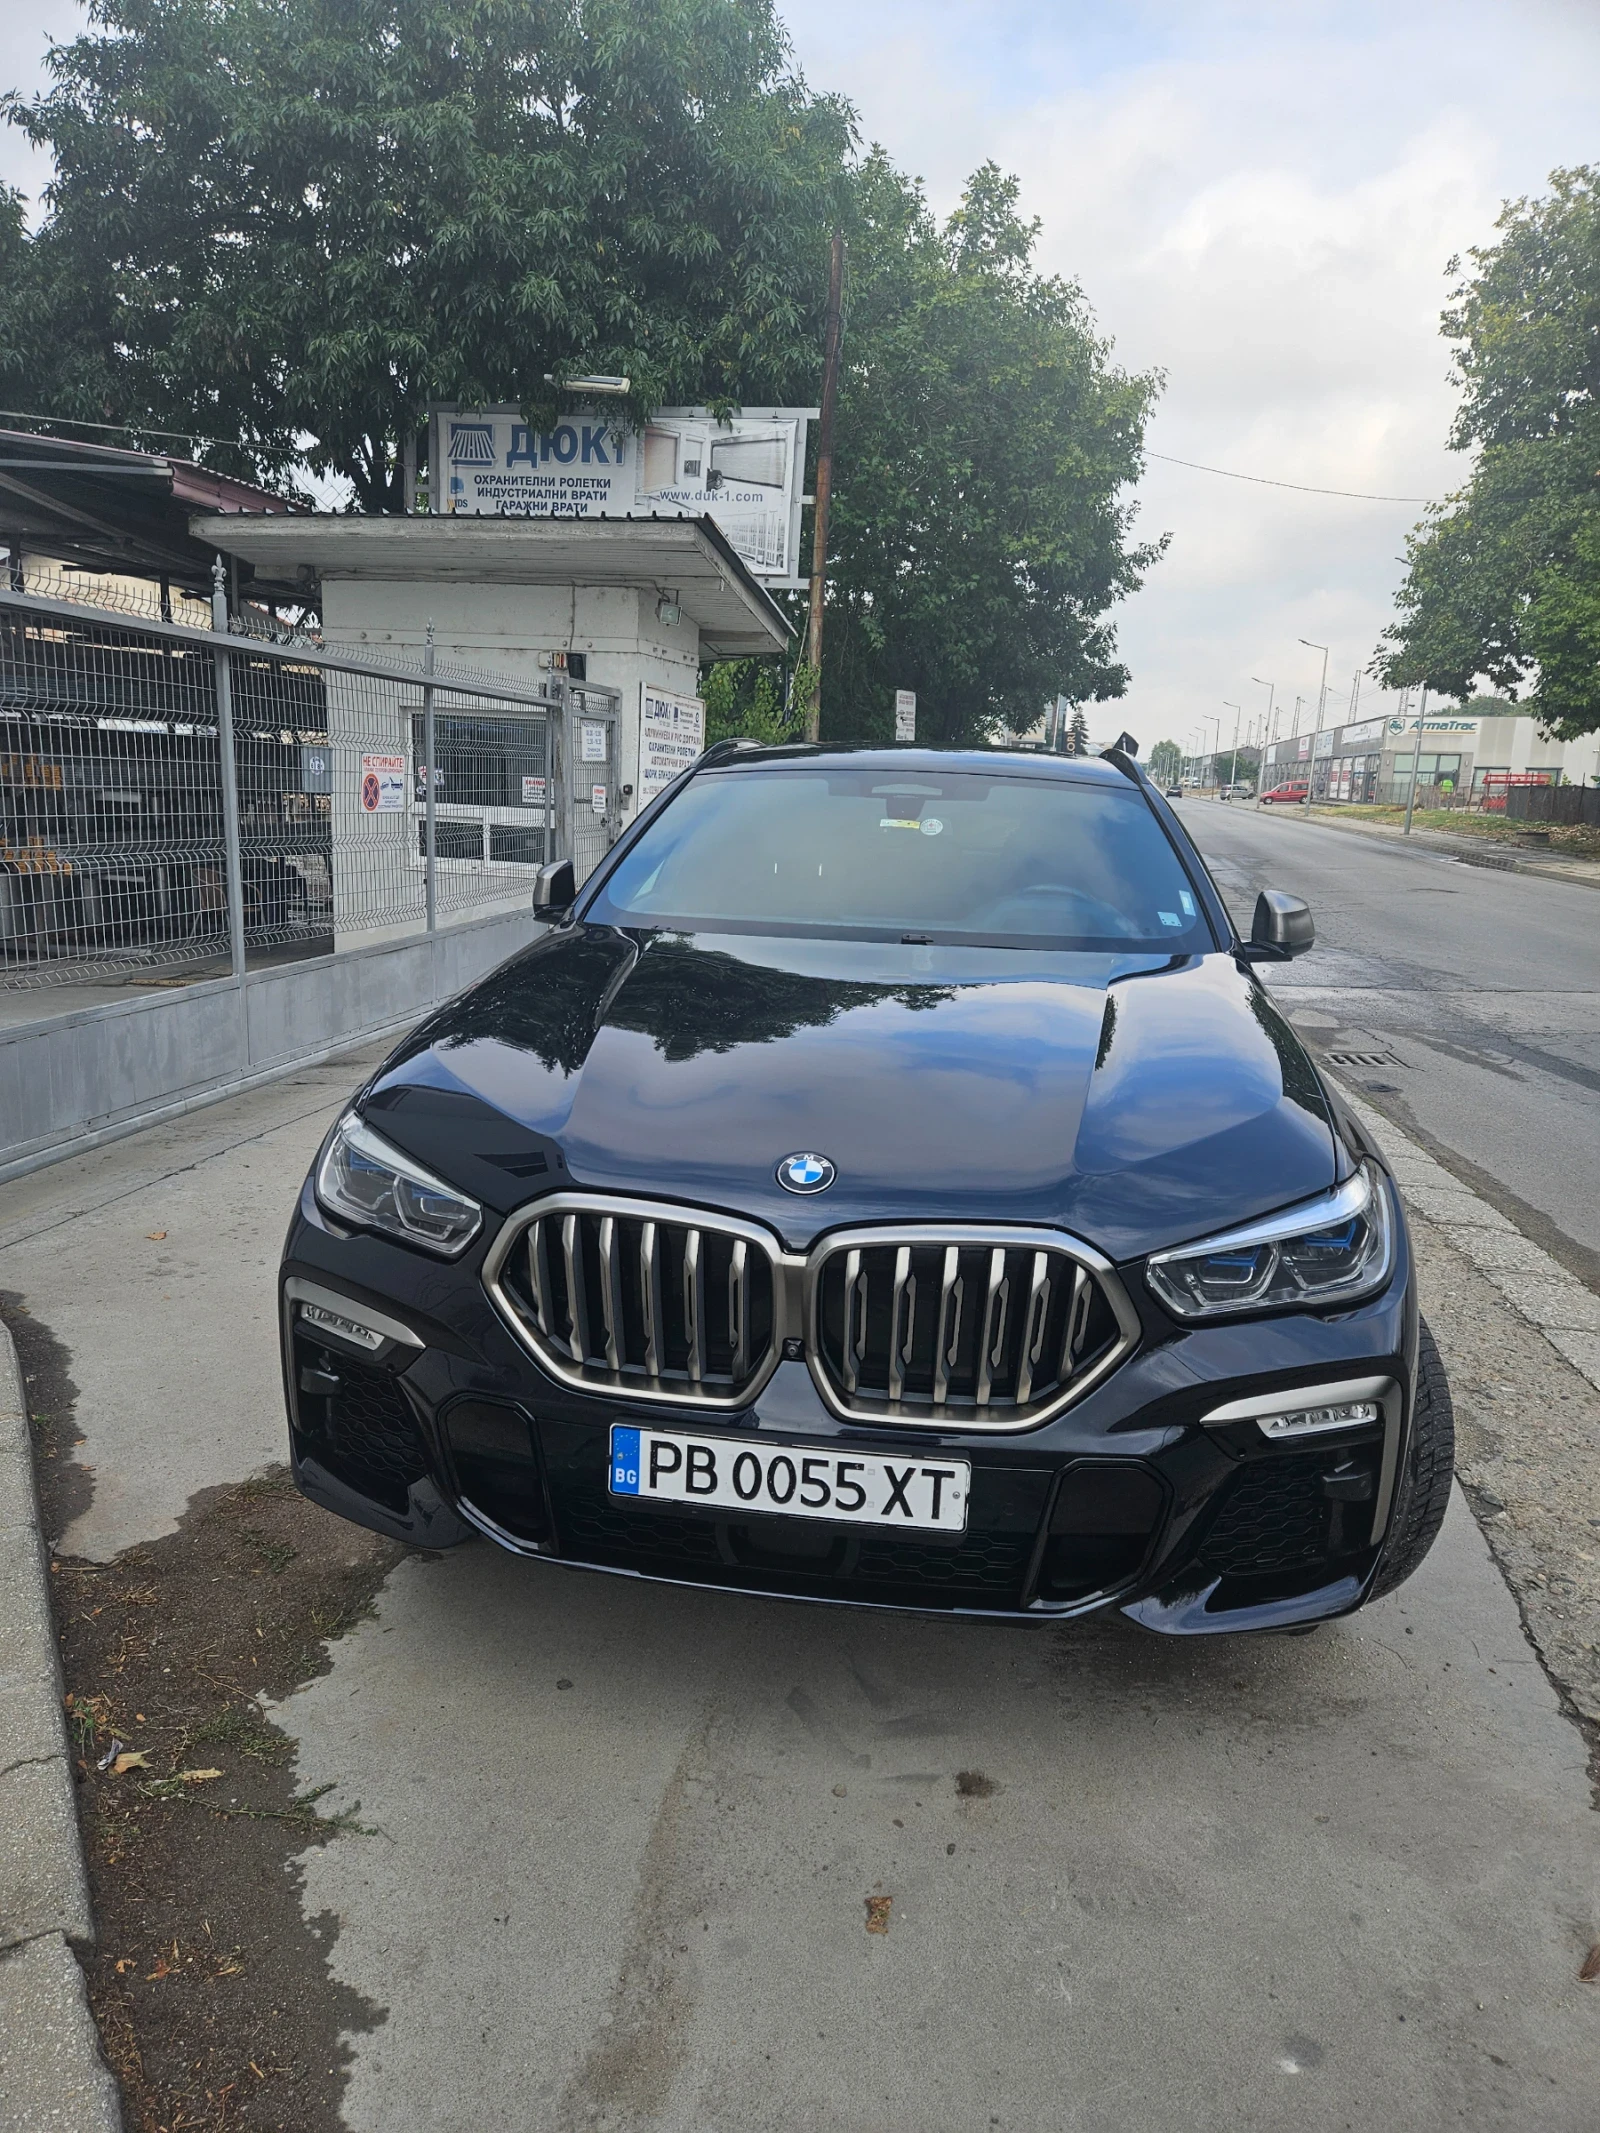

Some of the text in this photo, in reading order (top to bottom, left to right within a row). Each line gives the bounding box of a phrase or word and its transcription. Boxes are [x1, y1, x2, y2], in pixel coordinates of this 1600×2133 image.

[474, 474, 611, 488] ОХРАНИТЕЛНИ РОЛЕТКИ
[477, 487, 607, 501] ИНДУСТРИАЛНИ ВРАТИ
[660, 489, 763, 502] www.duk-1.com
[496, 500, 588, 513] ГАРАЖНИ ВРАТИ
[1409, 720, 1478, 731] ArmaTrac
[363, 755, 371, 767] НЕ
[786, 1153, 831, 1168] BMW
[615, 1468, 637, 1485] BG
[649, 1440, 956, 1520] PB 0055 XT
